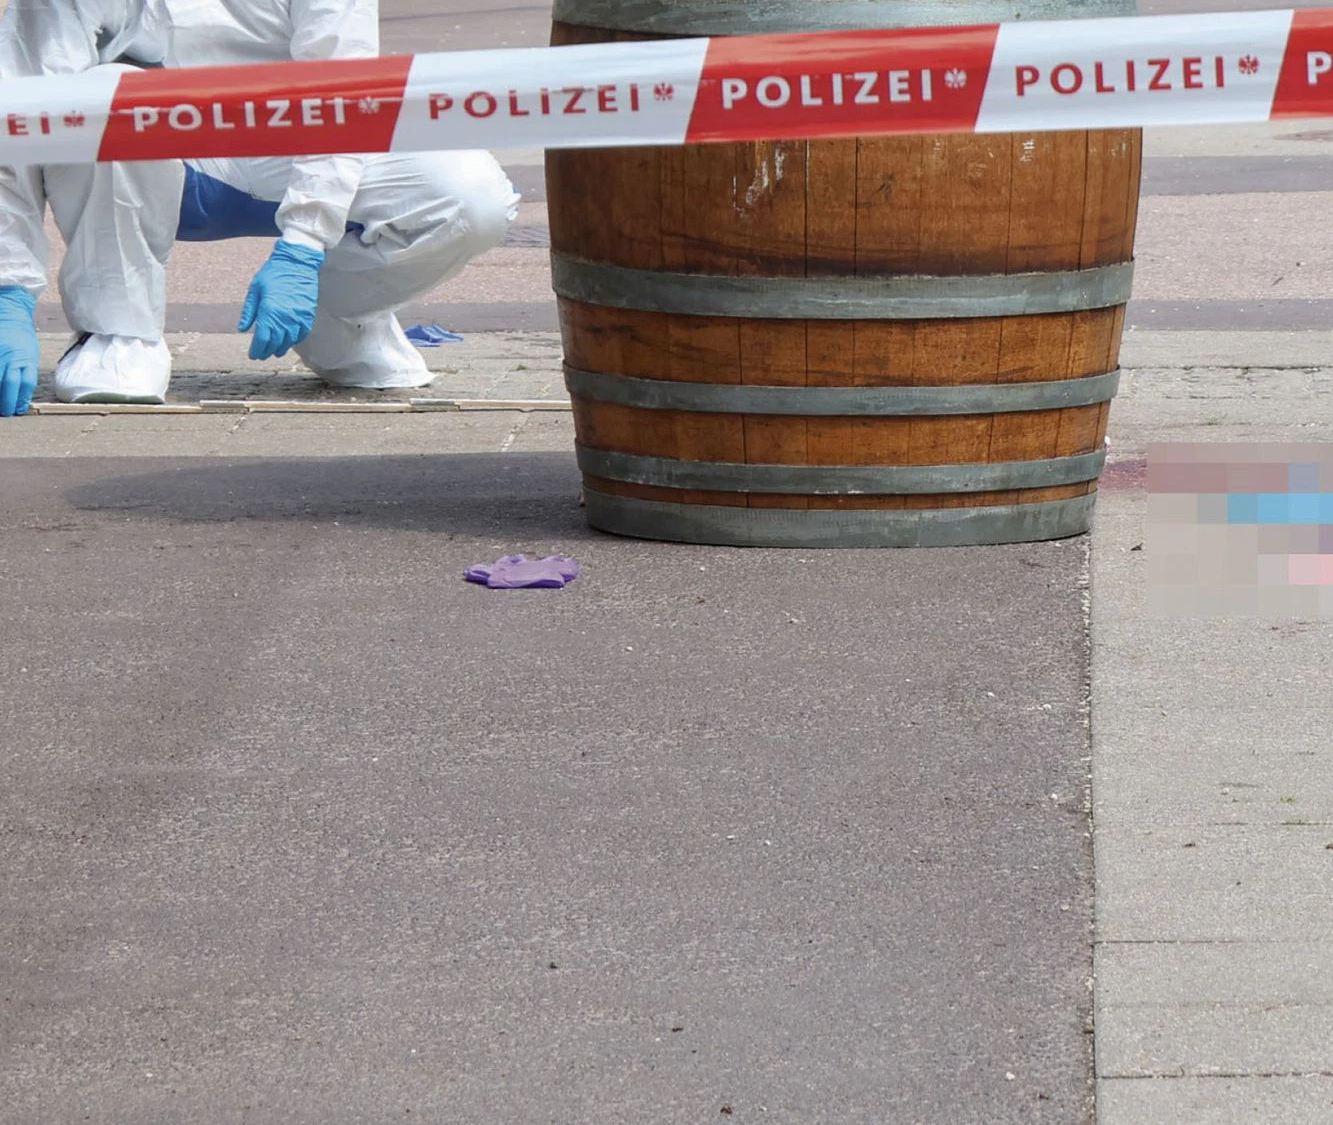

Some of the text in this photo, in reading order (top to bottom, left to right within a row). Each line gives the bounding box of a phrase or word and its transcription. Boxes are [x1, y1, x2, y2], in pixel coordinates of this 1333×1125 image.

[134, 96, 347, 132] POLIZEI
[429, 83, 639, 120] POLIZEI
[722, 68, 932, 109] POLIZEI
[1016, 56, 1225, 97] POLIZEI
